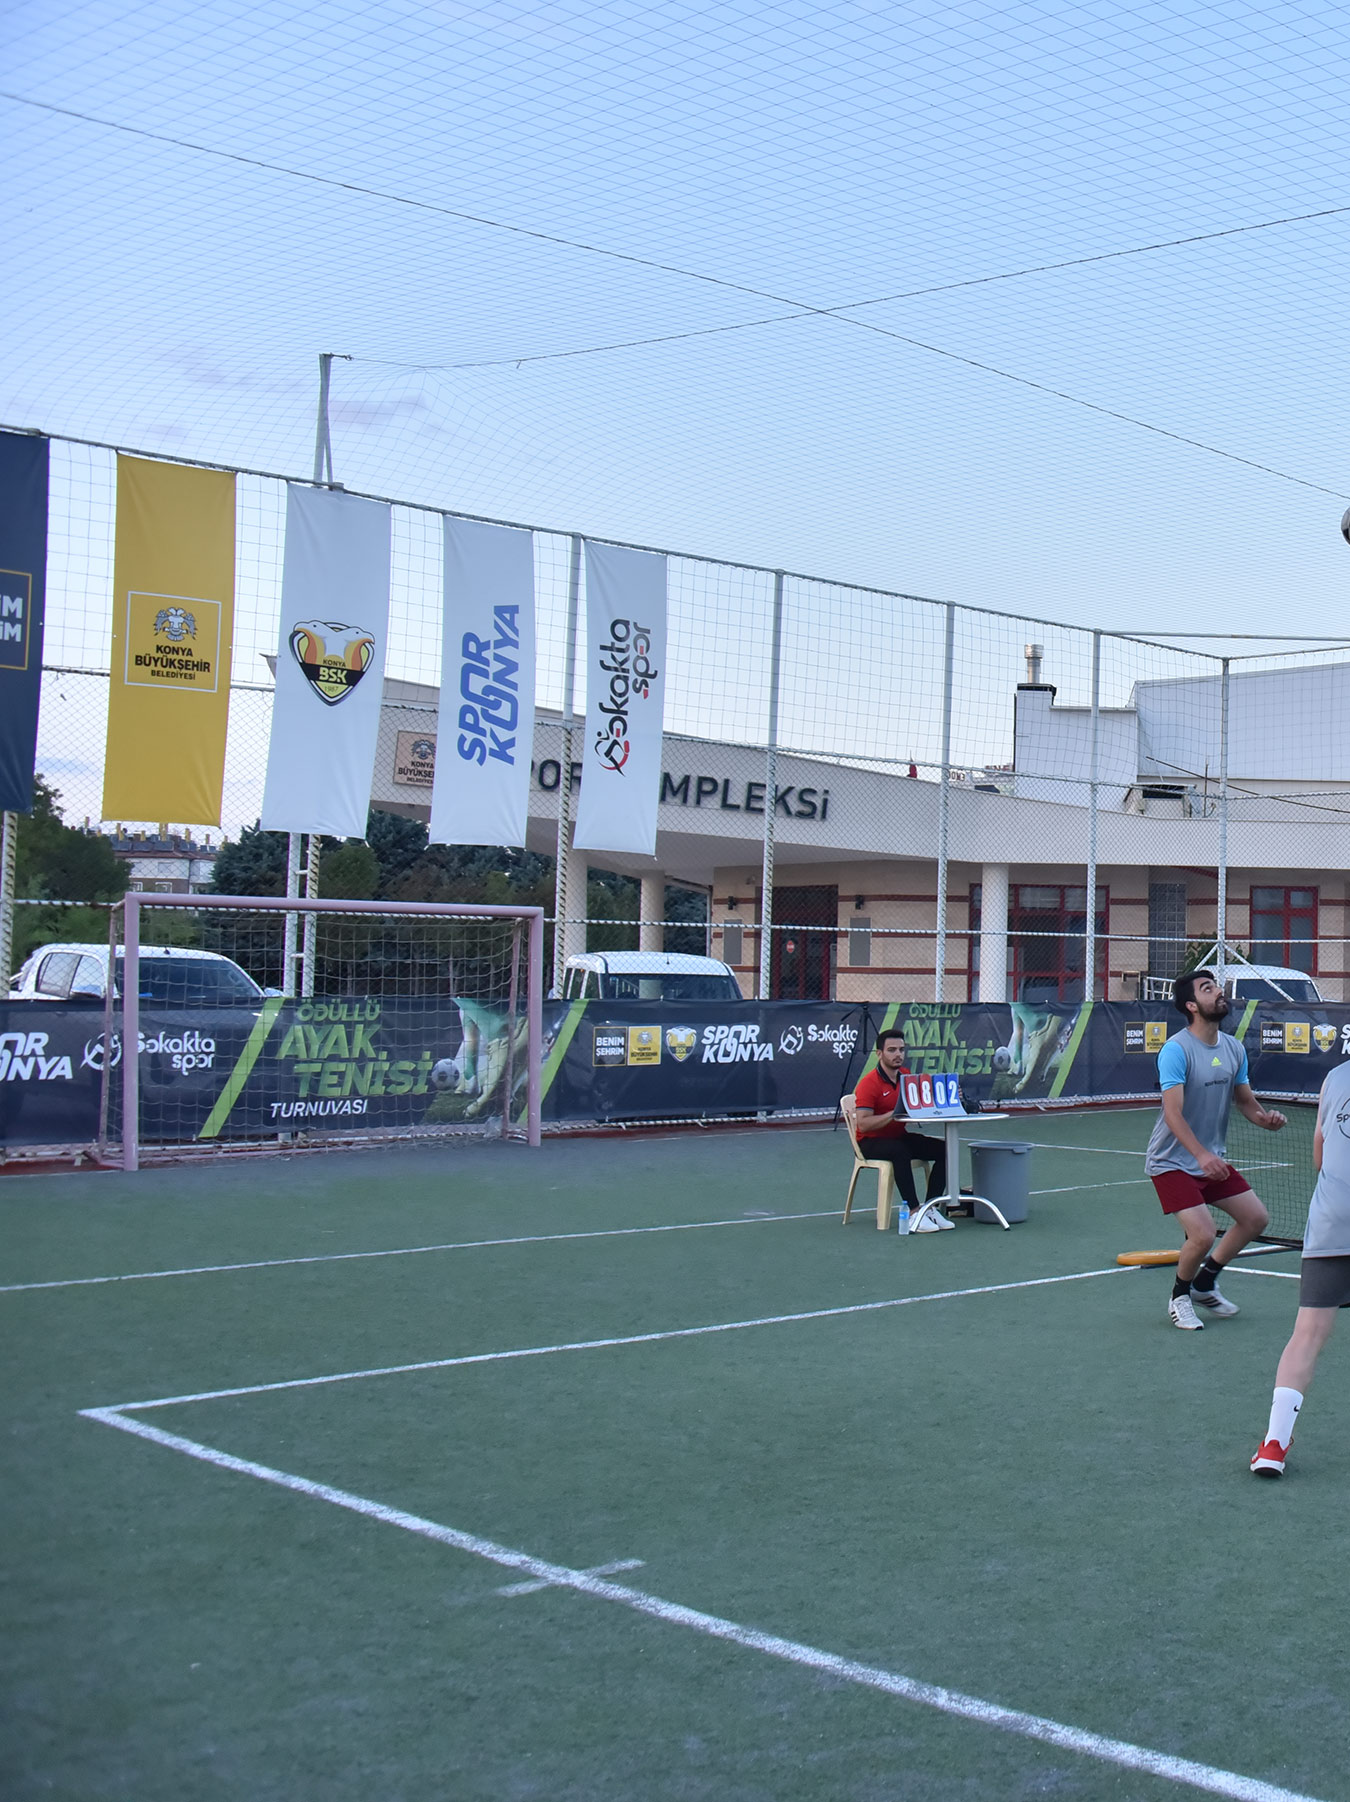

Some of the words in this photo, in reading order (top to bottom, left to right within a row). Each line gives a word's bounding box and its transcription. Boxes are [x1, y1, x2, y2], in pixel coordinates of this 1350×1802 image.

[156, 644, 193, 657] KONYA
[322, 658, 346, 667] KONYA
[632, 621, 658, 699] spor
[135, 653, 210, 673] BÜYÜKŞEHİR
[318, 666, 347, 684] BSK
[481, 604, 519, 766] KONYA
[457, 632, 502, 767] SPOR
[298, 999, 381, 1022] ÖDÜLLÜ
[276, 1024, 382, 1060] AYAK
[701, 1025, 760, 1048] SPOR
[902, 1019, 963, 1048] AYAK
[702, 1038, 774, 1063] KONYA
[832, 1041, 855, 1059] spo
[907, 1040, 996, 1076] TENİSİ
[294, 1051, 433, 1098] TENİSİ
[270, 1099, 368, 1118] TURNUVASI
